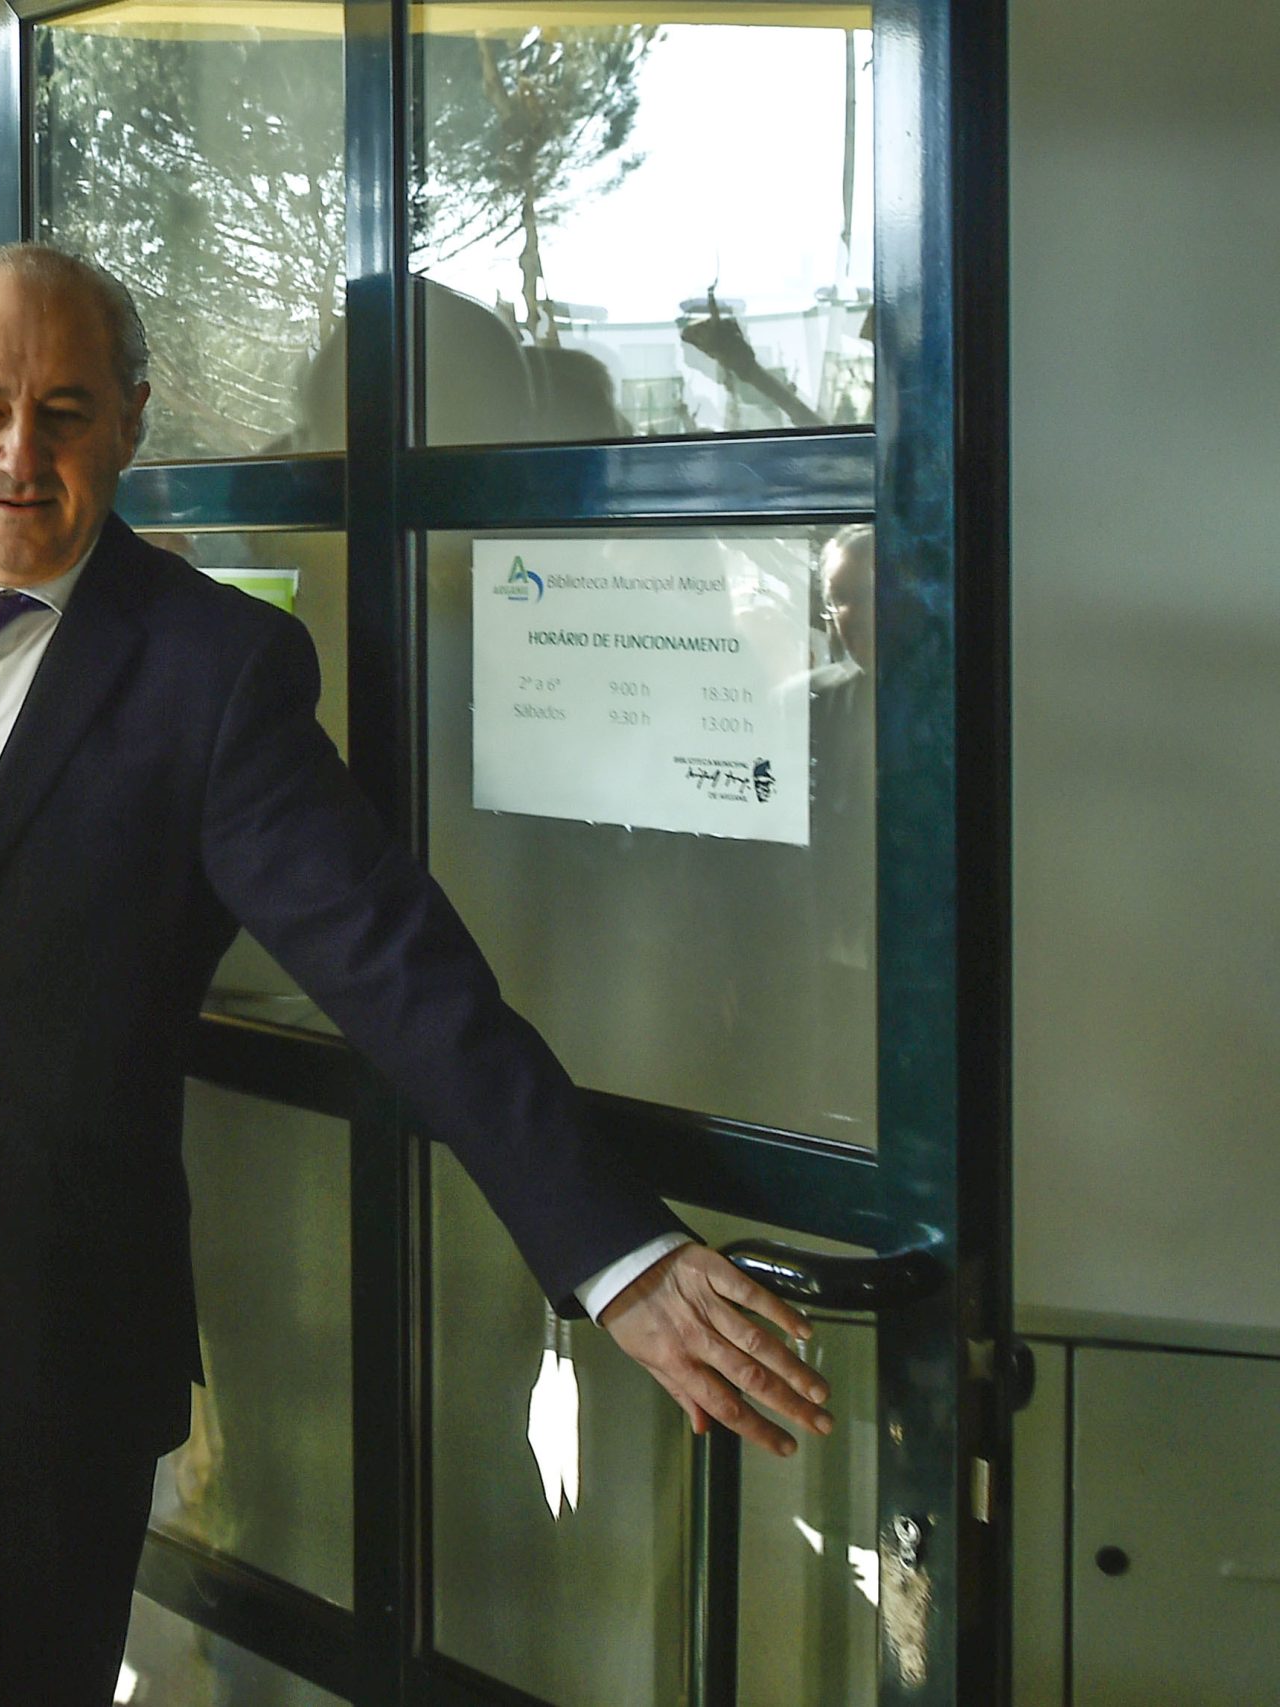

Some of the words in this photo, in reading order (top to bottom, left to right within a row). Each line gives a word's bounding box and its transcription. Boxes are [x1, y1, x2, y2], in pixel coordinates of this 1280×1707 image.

[546, 574, 609, 590] Biblioteca
[612, 575, 675, 594] Municipal
[679, 574, 727, 596] Miguel
[528, 628, 589, 648] HORÁRIO
[592, 632, 610, 648] DE
[614, 634, 741, 654] FUNCIONAMENTO
[641, 680, 651, 697] h
[742, 687, 753, 704] h
[641, 710, 651, 727] h
[743, 716, 754, 734] h
